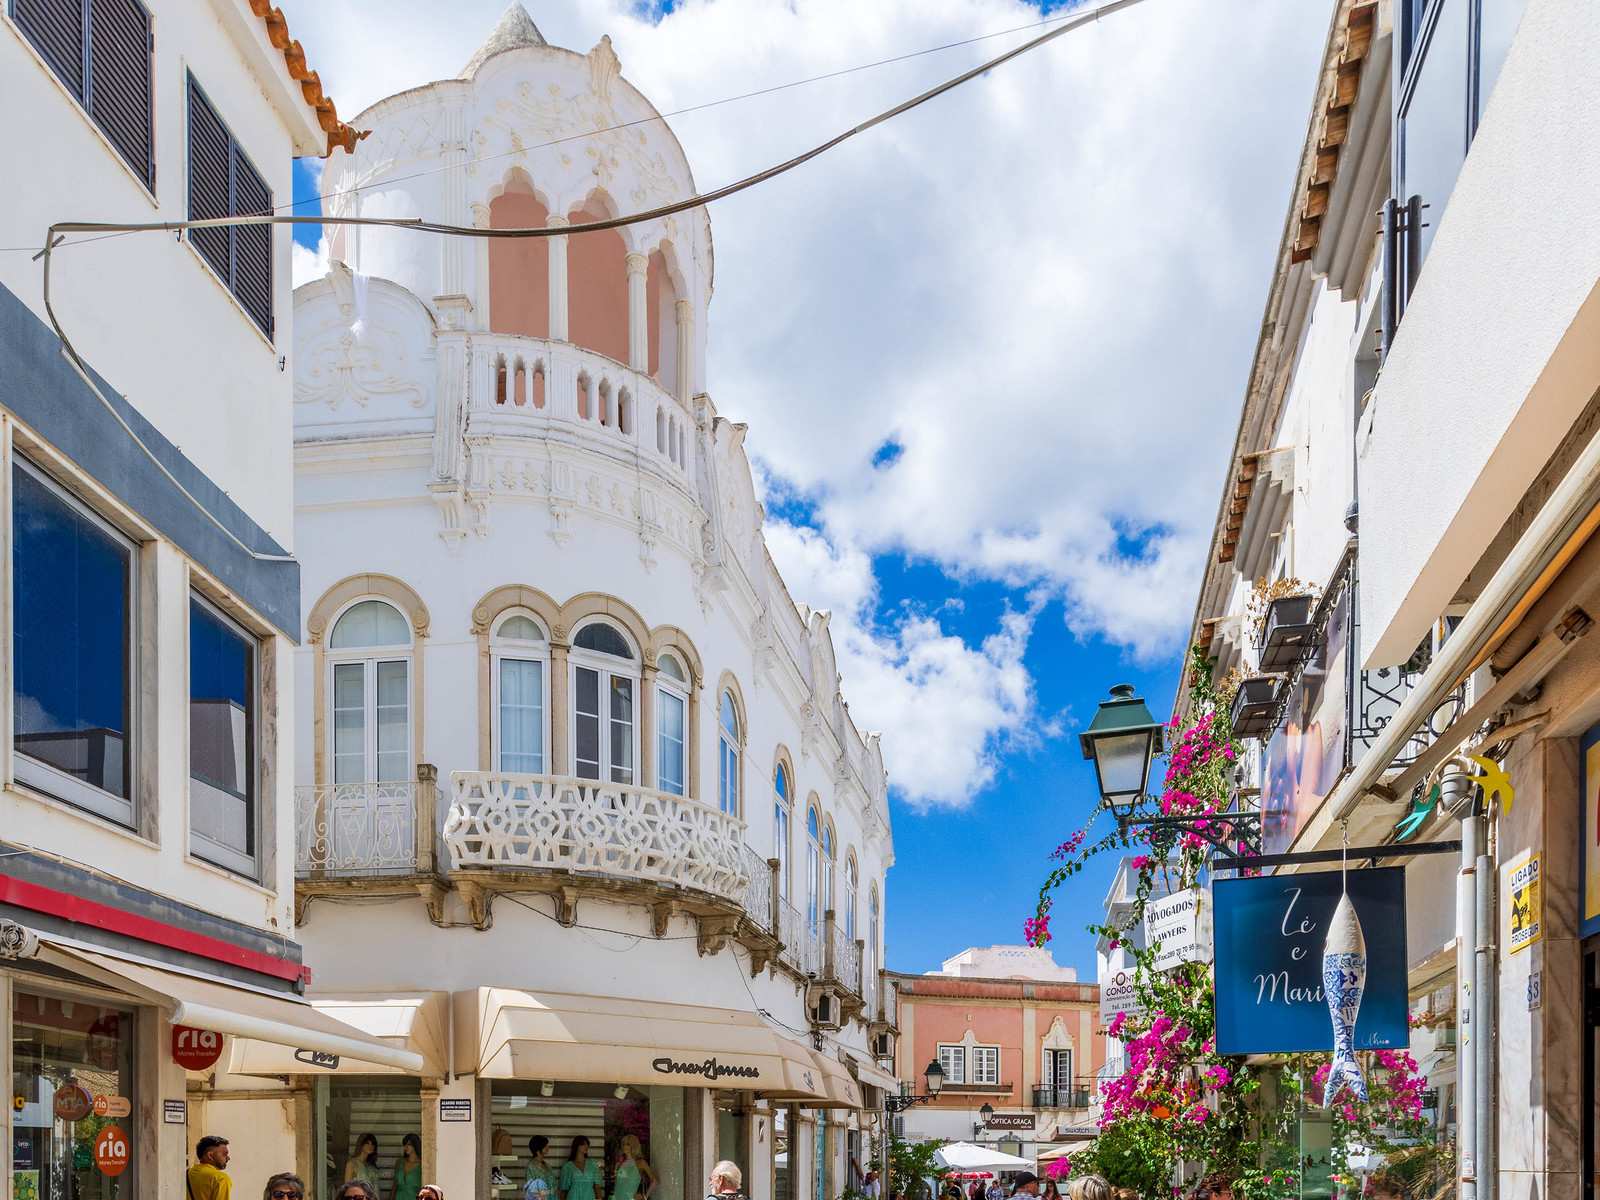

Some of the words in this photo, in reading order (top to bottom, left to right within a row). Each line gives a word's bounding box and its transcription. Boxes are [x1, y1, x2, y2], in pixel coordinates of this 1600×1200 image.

[1511, 859, 1538, 887] LIGADO
[1147, 899, 1193, 923] ADVOGADOS
[1281, 887, 1317, 937] Zé
[1153, 925, 1187, 943] LAWYERS
[1511, 923, 1539, 948] PROSEGUR
[1291, 946, 1307, 960] e
[1253, 970, 1328, 1005] Mari
[178, 1030, 216, 1048] ria
[57, 1097, 85, 1109] MTA
[94, 1097, 107, 1109] ria
[991, 1117, 1012, 1125] ÓPTICA
[99, 1132, 126, 1157] ria
